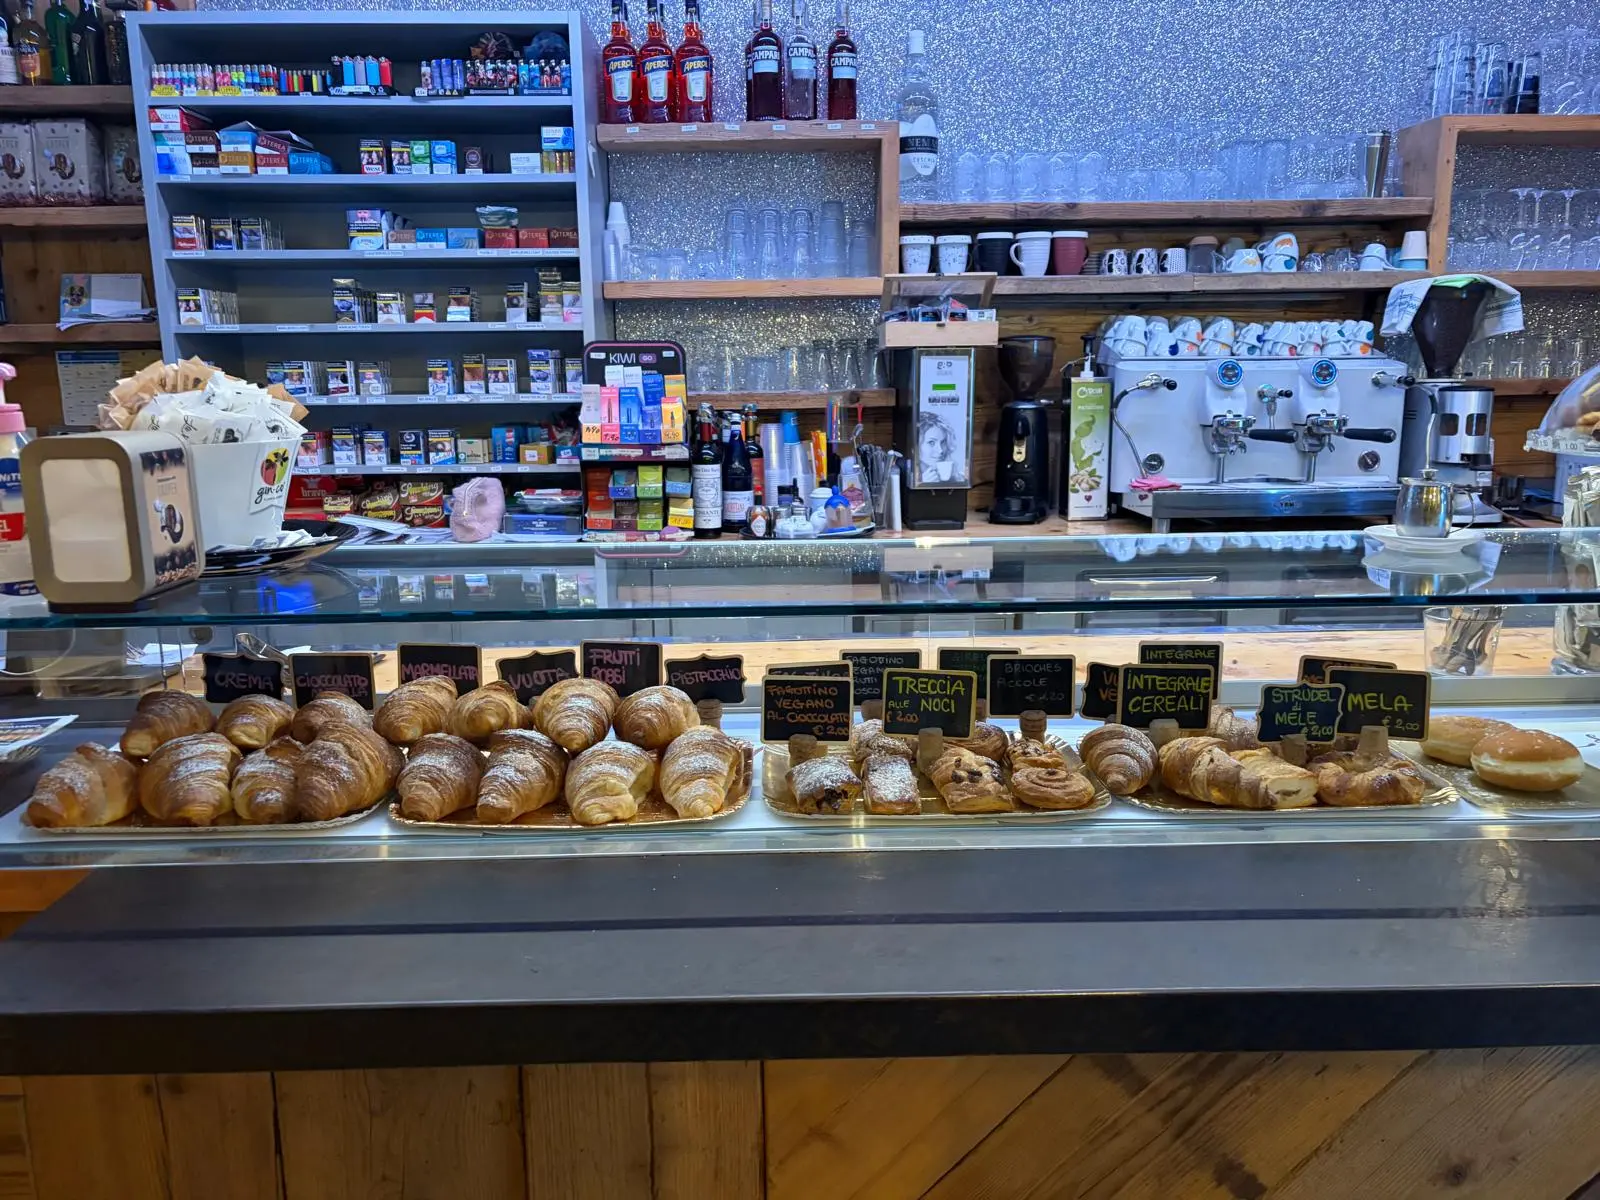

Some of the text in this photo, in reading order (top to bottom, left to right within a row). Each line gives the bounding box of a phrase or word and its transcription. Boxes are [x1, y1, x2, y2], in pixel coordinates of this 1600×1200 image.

[608, 59, 634, 72] APEROL
[644, 59, 669, 72] APEROL
[684, 59, 709, 72] APEROL
[609, 353, 636, 364] KIWI
[1145, 649, 1217, 660] INTEGRALE
[401, 662, 479, 681] MARMELLATA
[1004, 663, 1062, 674] BRIOCHES
[214, 671, 274, 692] CREMA
[508, 667, 570, 690] VUOTA
[854, 687, 881, 695] OSCO
[1271, 688, 1337, 704] STRUDEL
[775, 698, 835, 710] VEGANO
[888, 697, 956, 713] ALLE NOCI
[1347, 692, 1413, 712] MELA
[767, 710, 785, 721] AL
[1274, 711, 1318, 726] MELE
